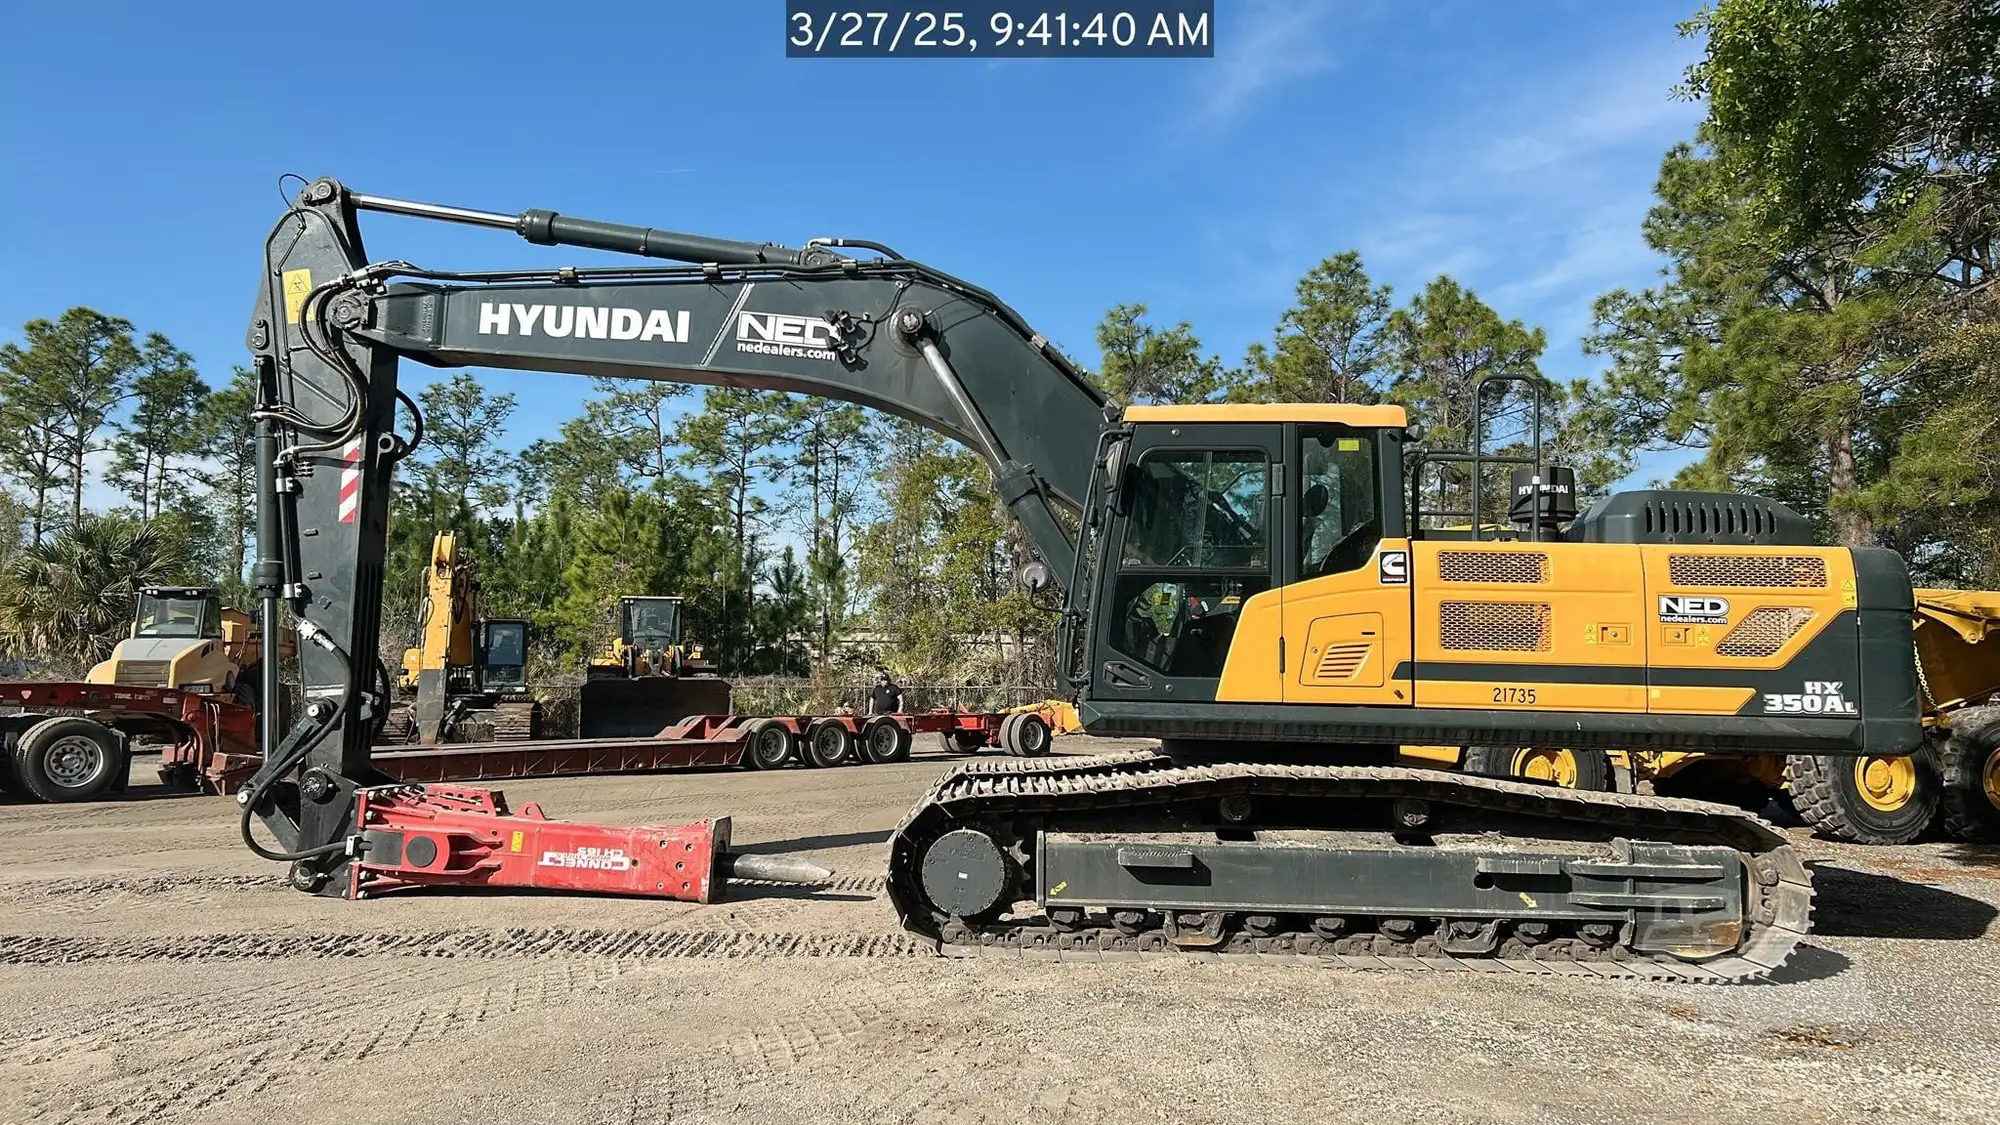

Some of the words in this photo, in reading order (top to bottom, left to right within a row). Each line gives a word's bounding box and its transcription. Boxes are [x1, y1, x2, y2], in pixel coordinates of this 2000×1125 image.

[478, 302, 690, 343] HYUNDAI
[738, 311, 841, 348] NED
[737, 342, 836, 360] nedealers.com
[1518, 484, 1569, 495] HYNDAI
[1658, 595, 1729, 616] NED
[1660, 615, 1727, 624] nedealers.com
[1492, 687, 1537, 704] 21735
[1804, 681, 1843, 695] HX
[537, 851, 631, 871] CONNECT
